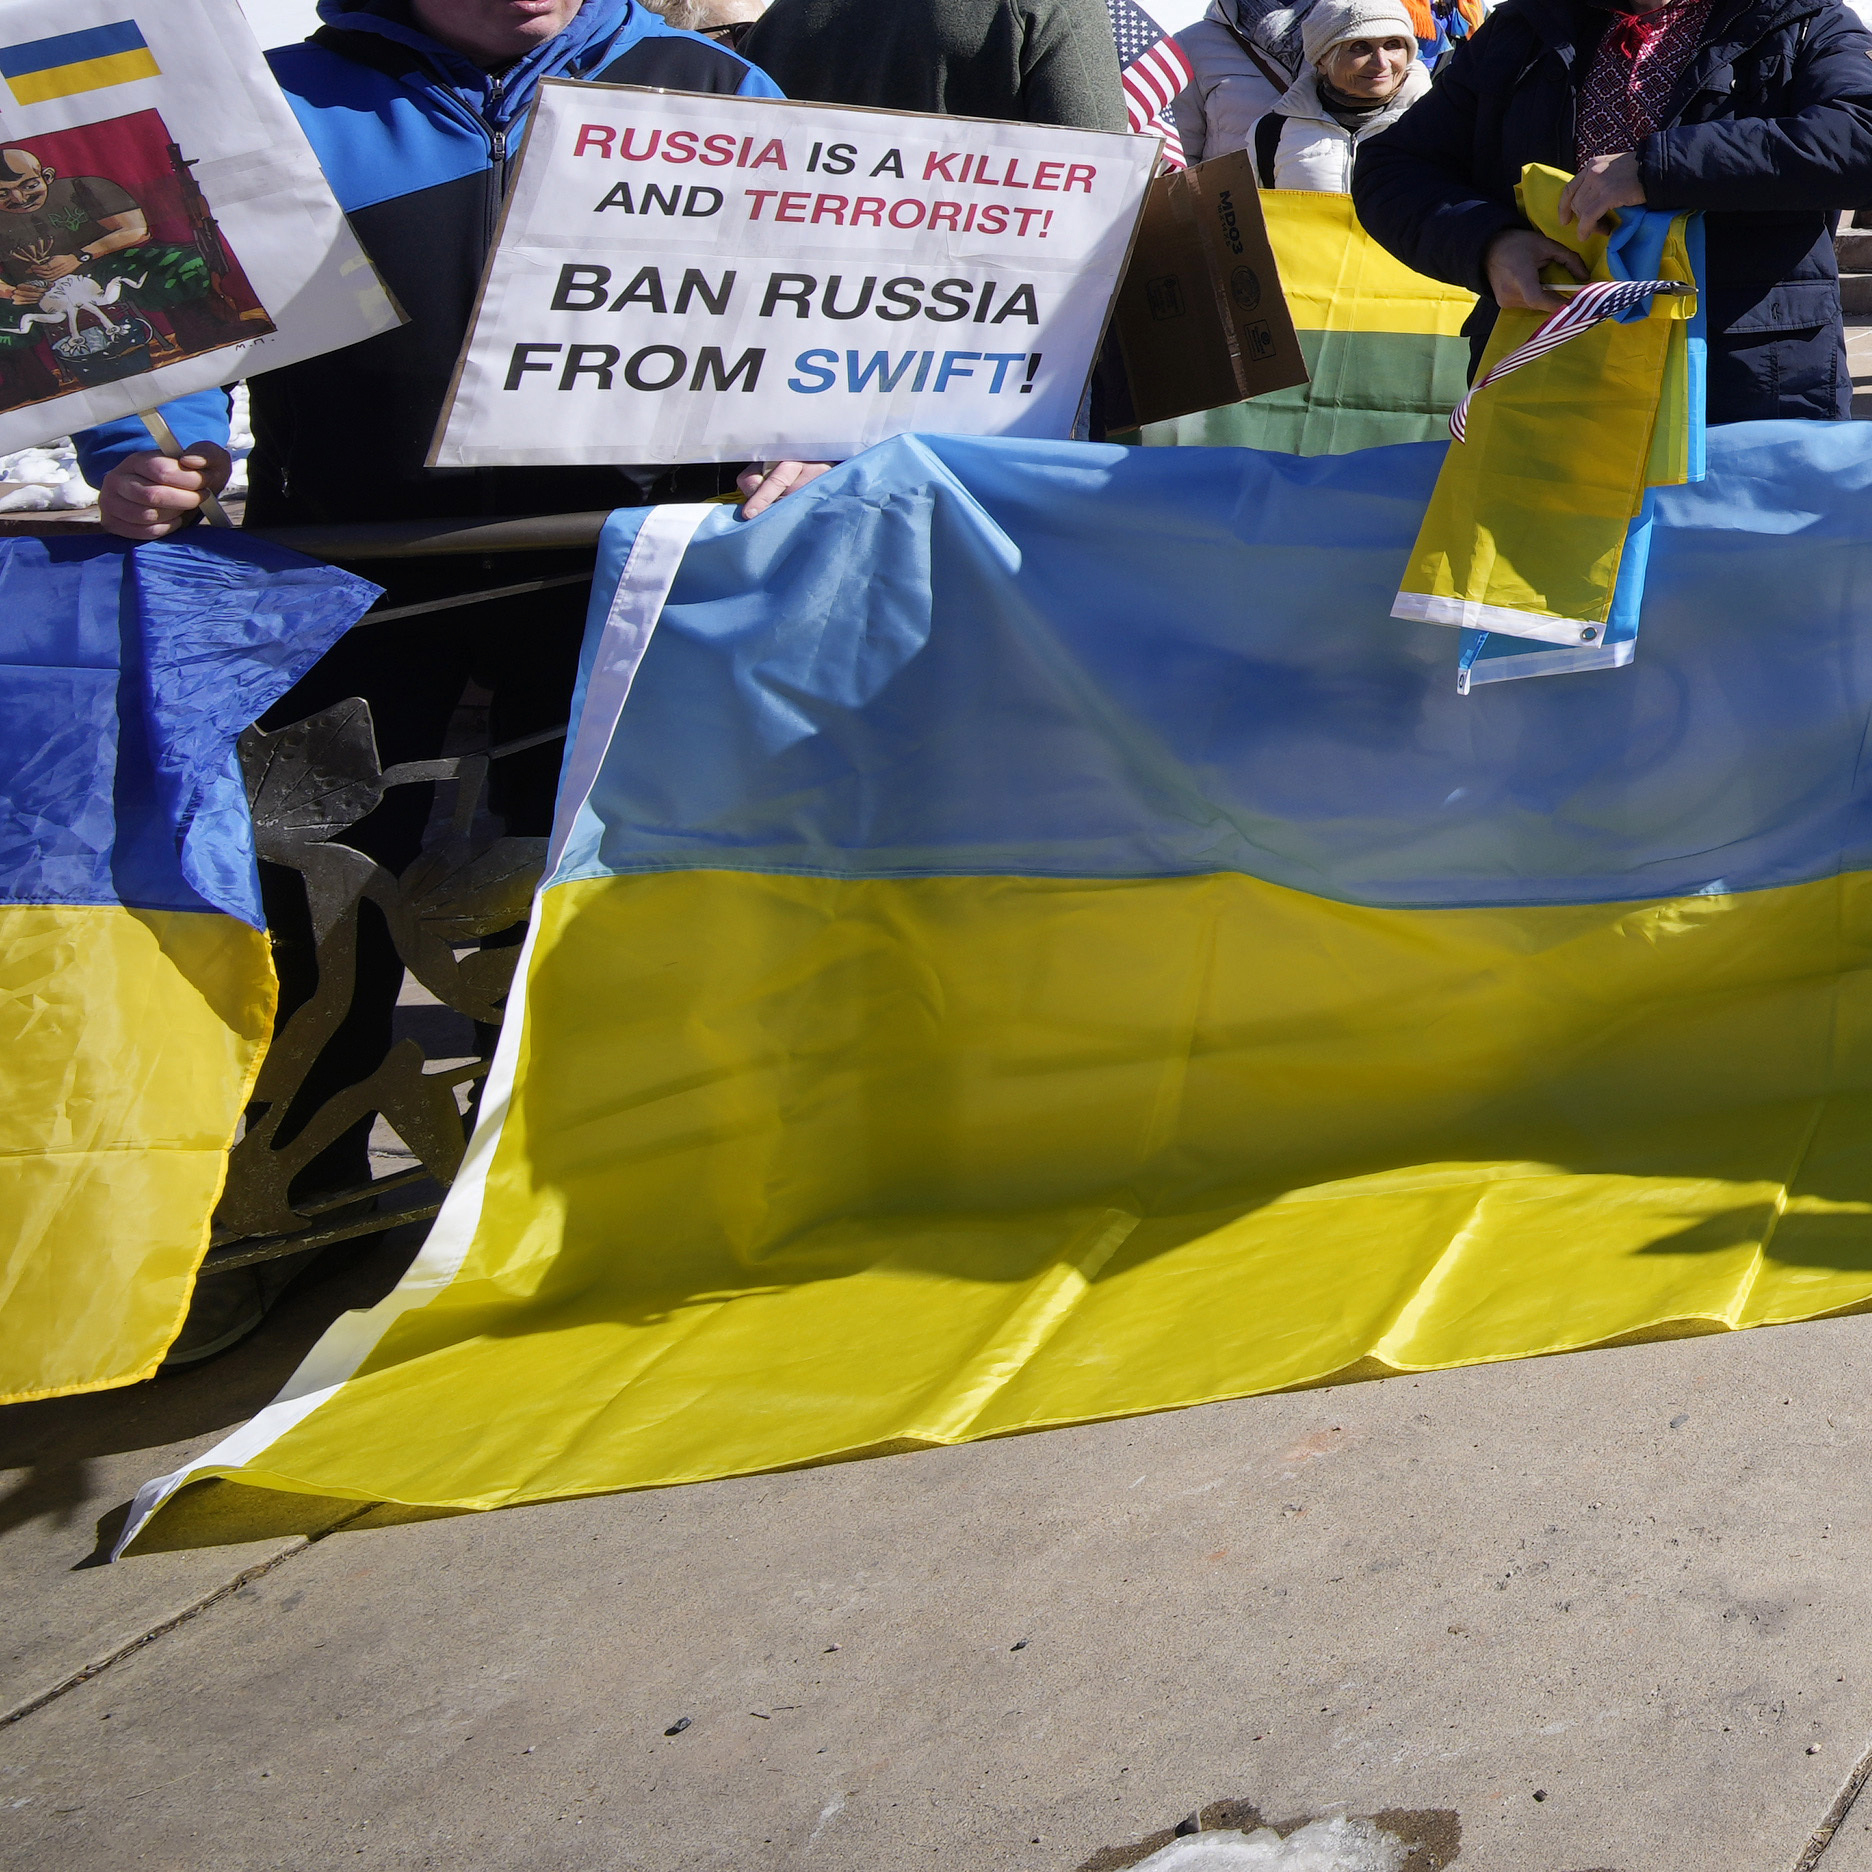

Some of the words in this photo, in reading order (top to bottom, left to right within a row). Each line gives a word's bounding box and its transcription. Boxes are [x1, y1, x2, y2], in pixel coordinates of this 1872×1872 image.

[573, 123, 790, 171] RUSSIA
[806, 141, 857, 176] IS
[869, 147, 906, 179] A
[922, 150, 1098, 194] KILLER
[593, 181, 725, 218] AND
[743, 188, 1054, 239] TERRORIST!
[549, 263, 738, 316] BAN
[758, 271, 1041, 326] RUSSIA
[502, 342, 768, 393] FROM
[786, 348, 1044, 396] SWIFT!
